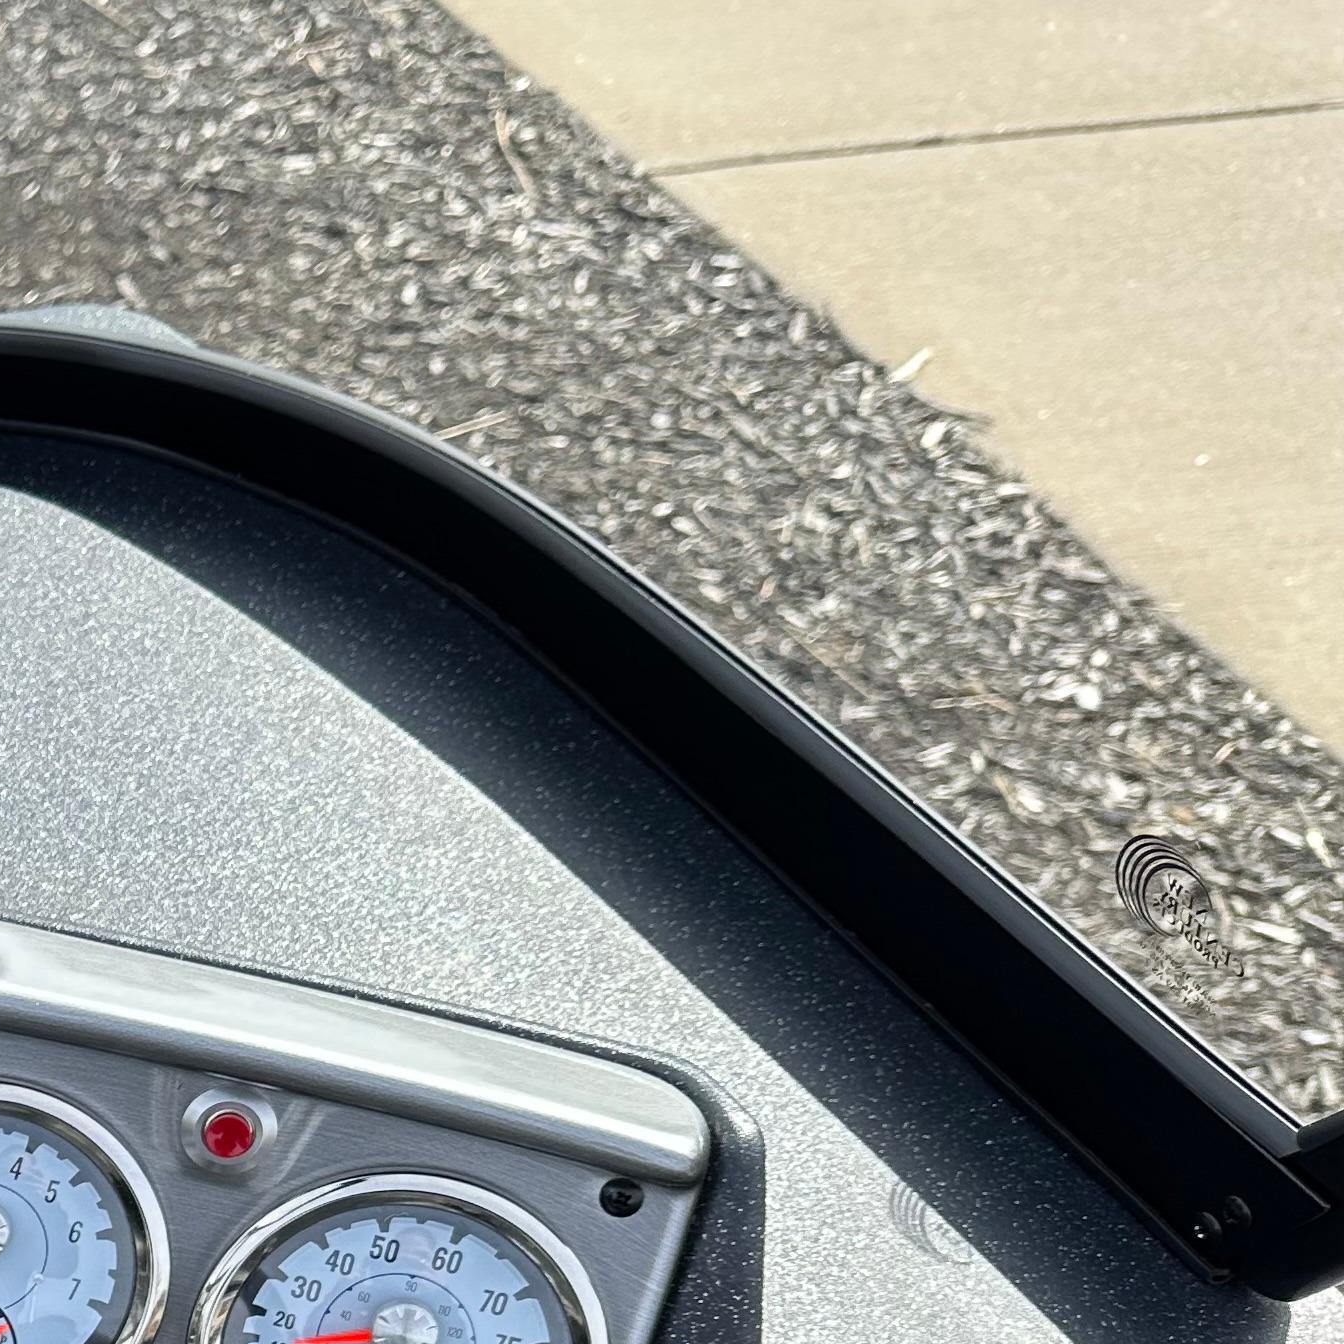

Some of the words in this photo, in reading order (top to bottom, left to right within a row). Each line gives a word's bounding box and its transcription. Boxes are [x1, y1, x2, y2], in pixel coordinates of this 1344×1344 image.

[10, 1157, 23, 1179] 4
[45, 1181, 59, 1202] 5
[69, 1221, 82, 1243] 6
[370, 1235, 400, 1263] 50
[325, 1250, 355, 1276] 40
[432, 1247, 462, 1274] 60
[69, 1279, 81, 1300] 7
[291, 1275, 321, 1302] 30
[406, 1280, 417, 1293] 90
[358, 1291, 370, 1304] 60
[480, 1289, 508, 1316] 70
[273, 1311, 295, 1330] 20
[340, 1310, 351, 1321] 40
[446, 1327, 462, 1339] 120
